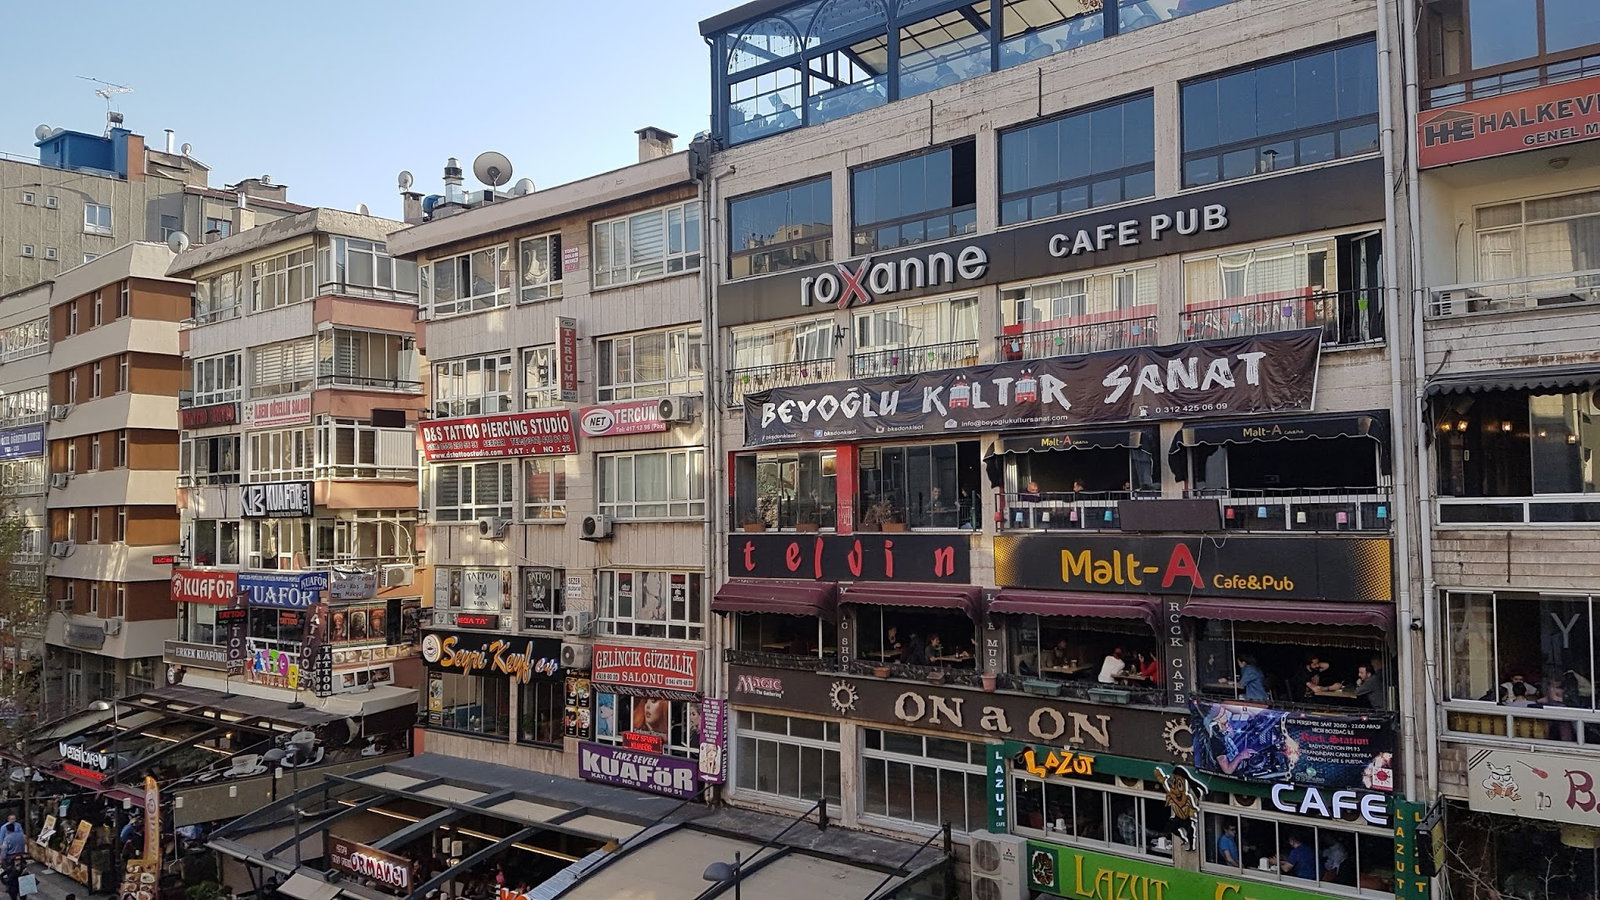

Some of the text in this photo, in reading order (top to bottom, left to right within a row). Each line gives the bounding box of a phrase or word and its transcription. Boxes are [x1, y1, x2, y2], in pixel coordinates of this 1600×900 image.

[1479, 92, 1600, 134] HALKEV
[1523, 126, 1579, 145] GENEL
[1048, 203, 1229, 259] CAFE PUB
[761, 386, 899, 429] BEYOĞLU
[1102, 352, 1266, 404] SANAT
[614, 404, 658, 424] TERCÜM
[1182, 404, 1199, 412] 425
[1203, 402, 1213, 410] 06
[1216, 402, 1228, 410] 09
[423, 413, 569, 442] D&S TATTOO PİERCİNG STUDİO
[590, 417, 606, 427] NET
[1243, 425, 1282, 438] Malt-A
[1041, 436, 1071, 447] Malt-A
[266, 483, 301, 511] KUAFÖR
[466, 571, 497, 584] TATTOO
[527, 572, 551, 584] TATTOO
[1061, 543, 1294, 591] Malt-A Cafe&Pub
[184, 575, 234, 599] KUAFÖR
[241, 584, 313, 607] KUAFÖR
[301, 574, 328, 591] KUAFÖR
[176, 647, 196, 658] ERKEK
[596, 648, 694, 677] GELİNCİK GÜZELLİK
[841, 638, 849, 671] SHOP
[322, 646, 331, 690] TATTOO
[622, 672, 664, 684] SALONU
[1172, 659, 1184, 703] CAFE
[736, 675, 782, 694] MAGIC
[894, 691, 1111, 748] ON a ON
[582, 749, 693, 791] KUAFÖR
[612, 751, 659, 767] TARZ SEVEN
[1024, 750, 1094, 778] LAZUT
[995, 751, 1004, 816] LAZUT
[1271, 783, 1387, 825] CAFE
[1396, 809, 1405, 889] LAZUT
